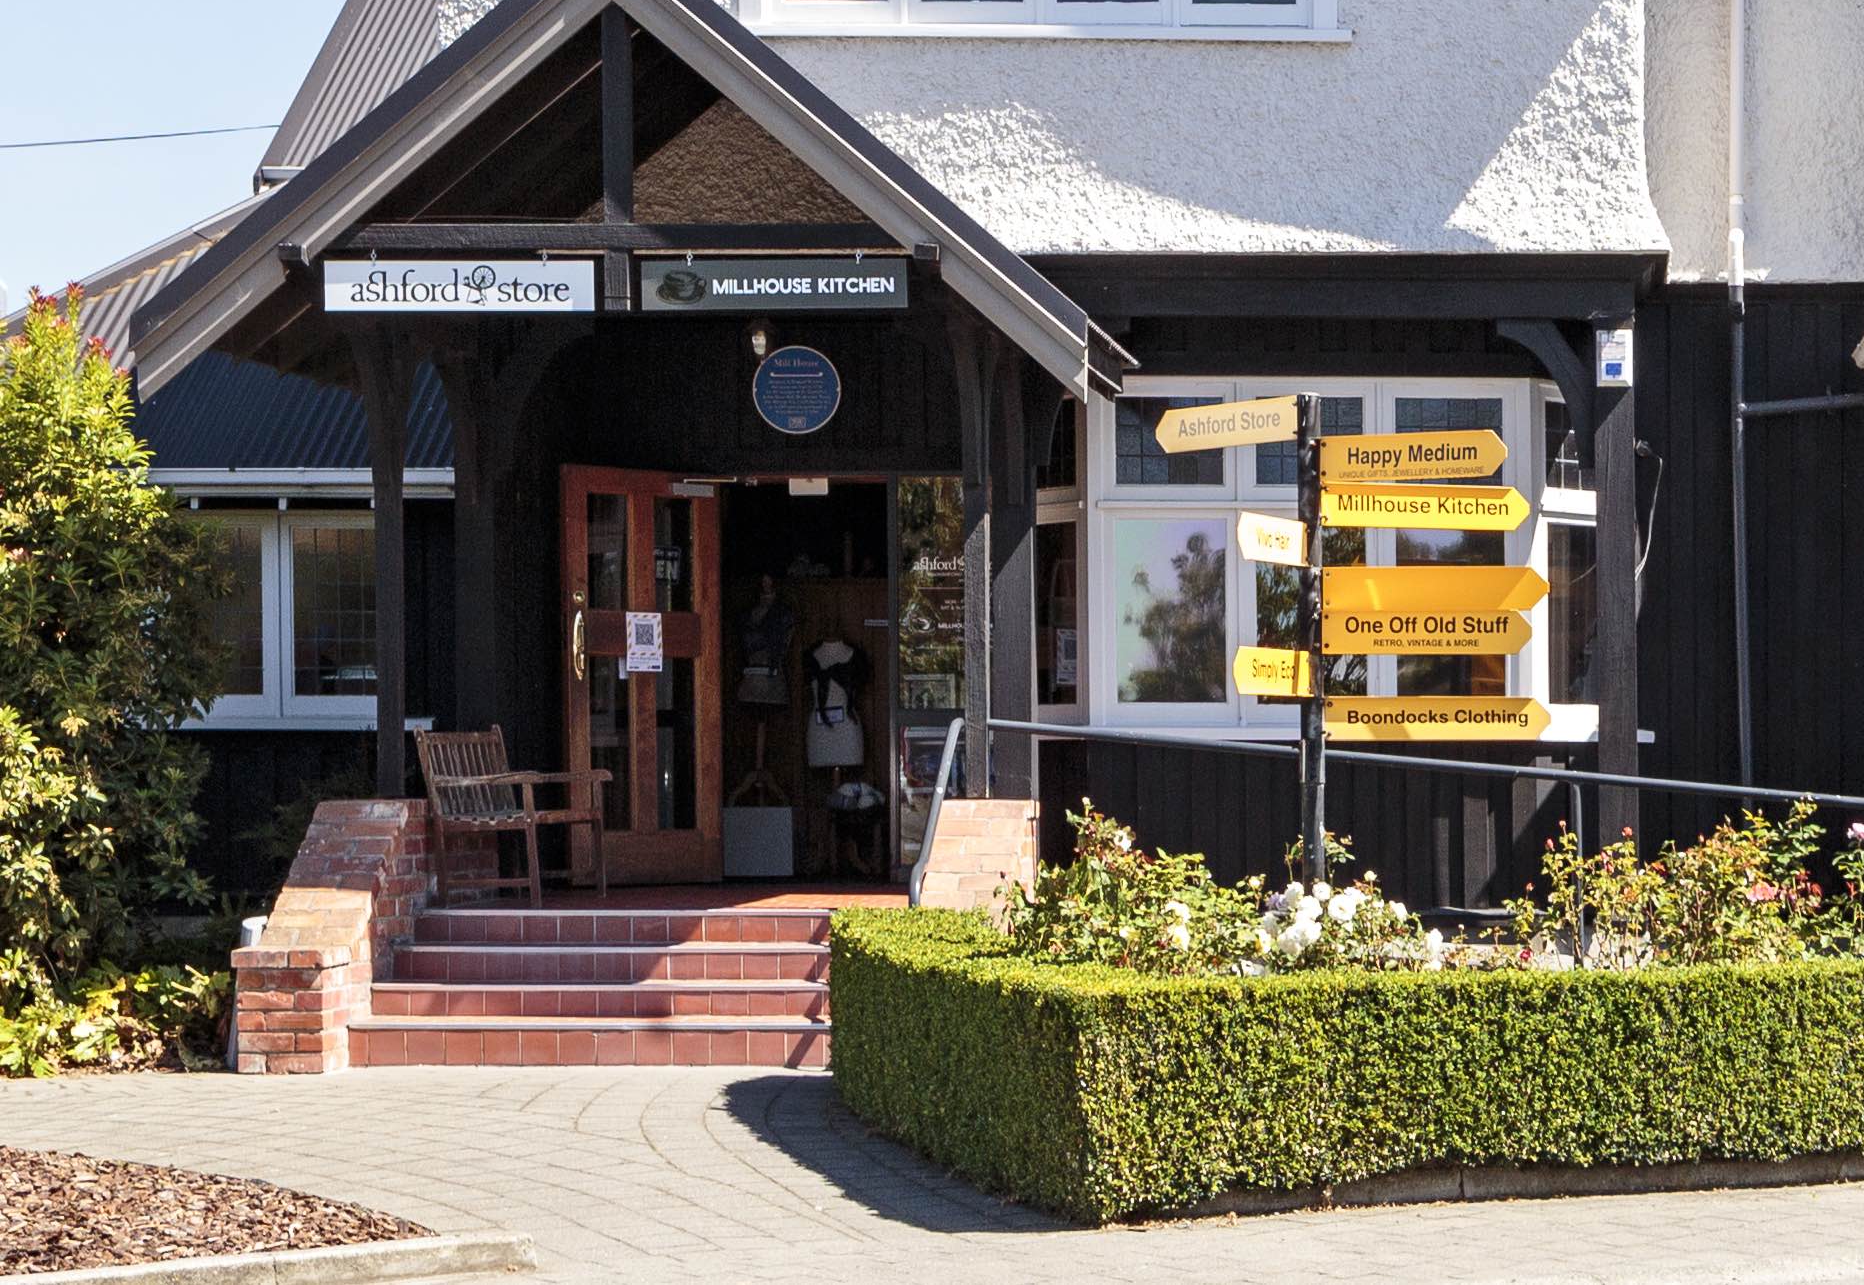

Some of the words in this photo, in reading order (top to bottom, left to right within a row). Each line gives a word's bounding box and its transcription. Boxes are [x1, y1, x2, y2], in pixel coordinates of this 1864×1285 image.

[351, 269, 459, 303] ashford
[498, 277, 570, 303] store
[712, 278, 812, 295] MILLHOUSE
[817, 277, 895, 294] KITCHEN
[1178, 414, 1236, 437] Ashford
[1240, 411, 1280, 431] Store
[1347, 447, 1402, 469] Happy
[1408, 443, 1478, 462] Medium
[1391, 468, 1434, 478] JEWELLERY
[1435, 467, 1440, 475] &
[1441, 465, 1485, 475] HOMEWARE
[1338, 495, 1431, 514] Millhouse
[1438, 497, 1509, 516] Kitchen
[1345, 616, 1384, 634] One
[1389, 616, 1417, 634] Off
[1423, 616, 1456, 634] Old
[1463, 616, 1509, 634] Stuff
[1407, 638, 1443, 647] VINTAGE
[1445, 638, 1452, 647] &
[1454, 638, 1480, 647] MORE
[1252, 658, 1279, 683] Simply
[1347, 710, 1449, 725] Boondocks
[1454, 710, 1529, 727] Clothing
